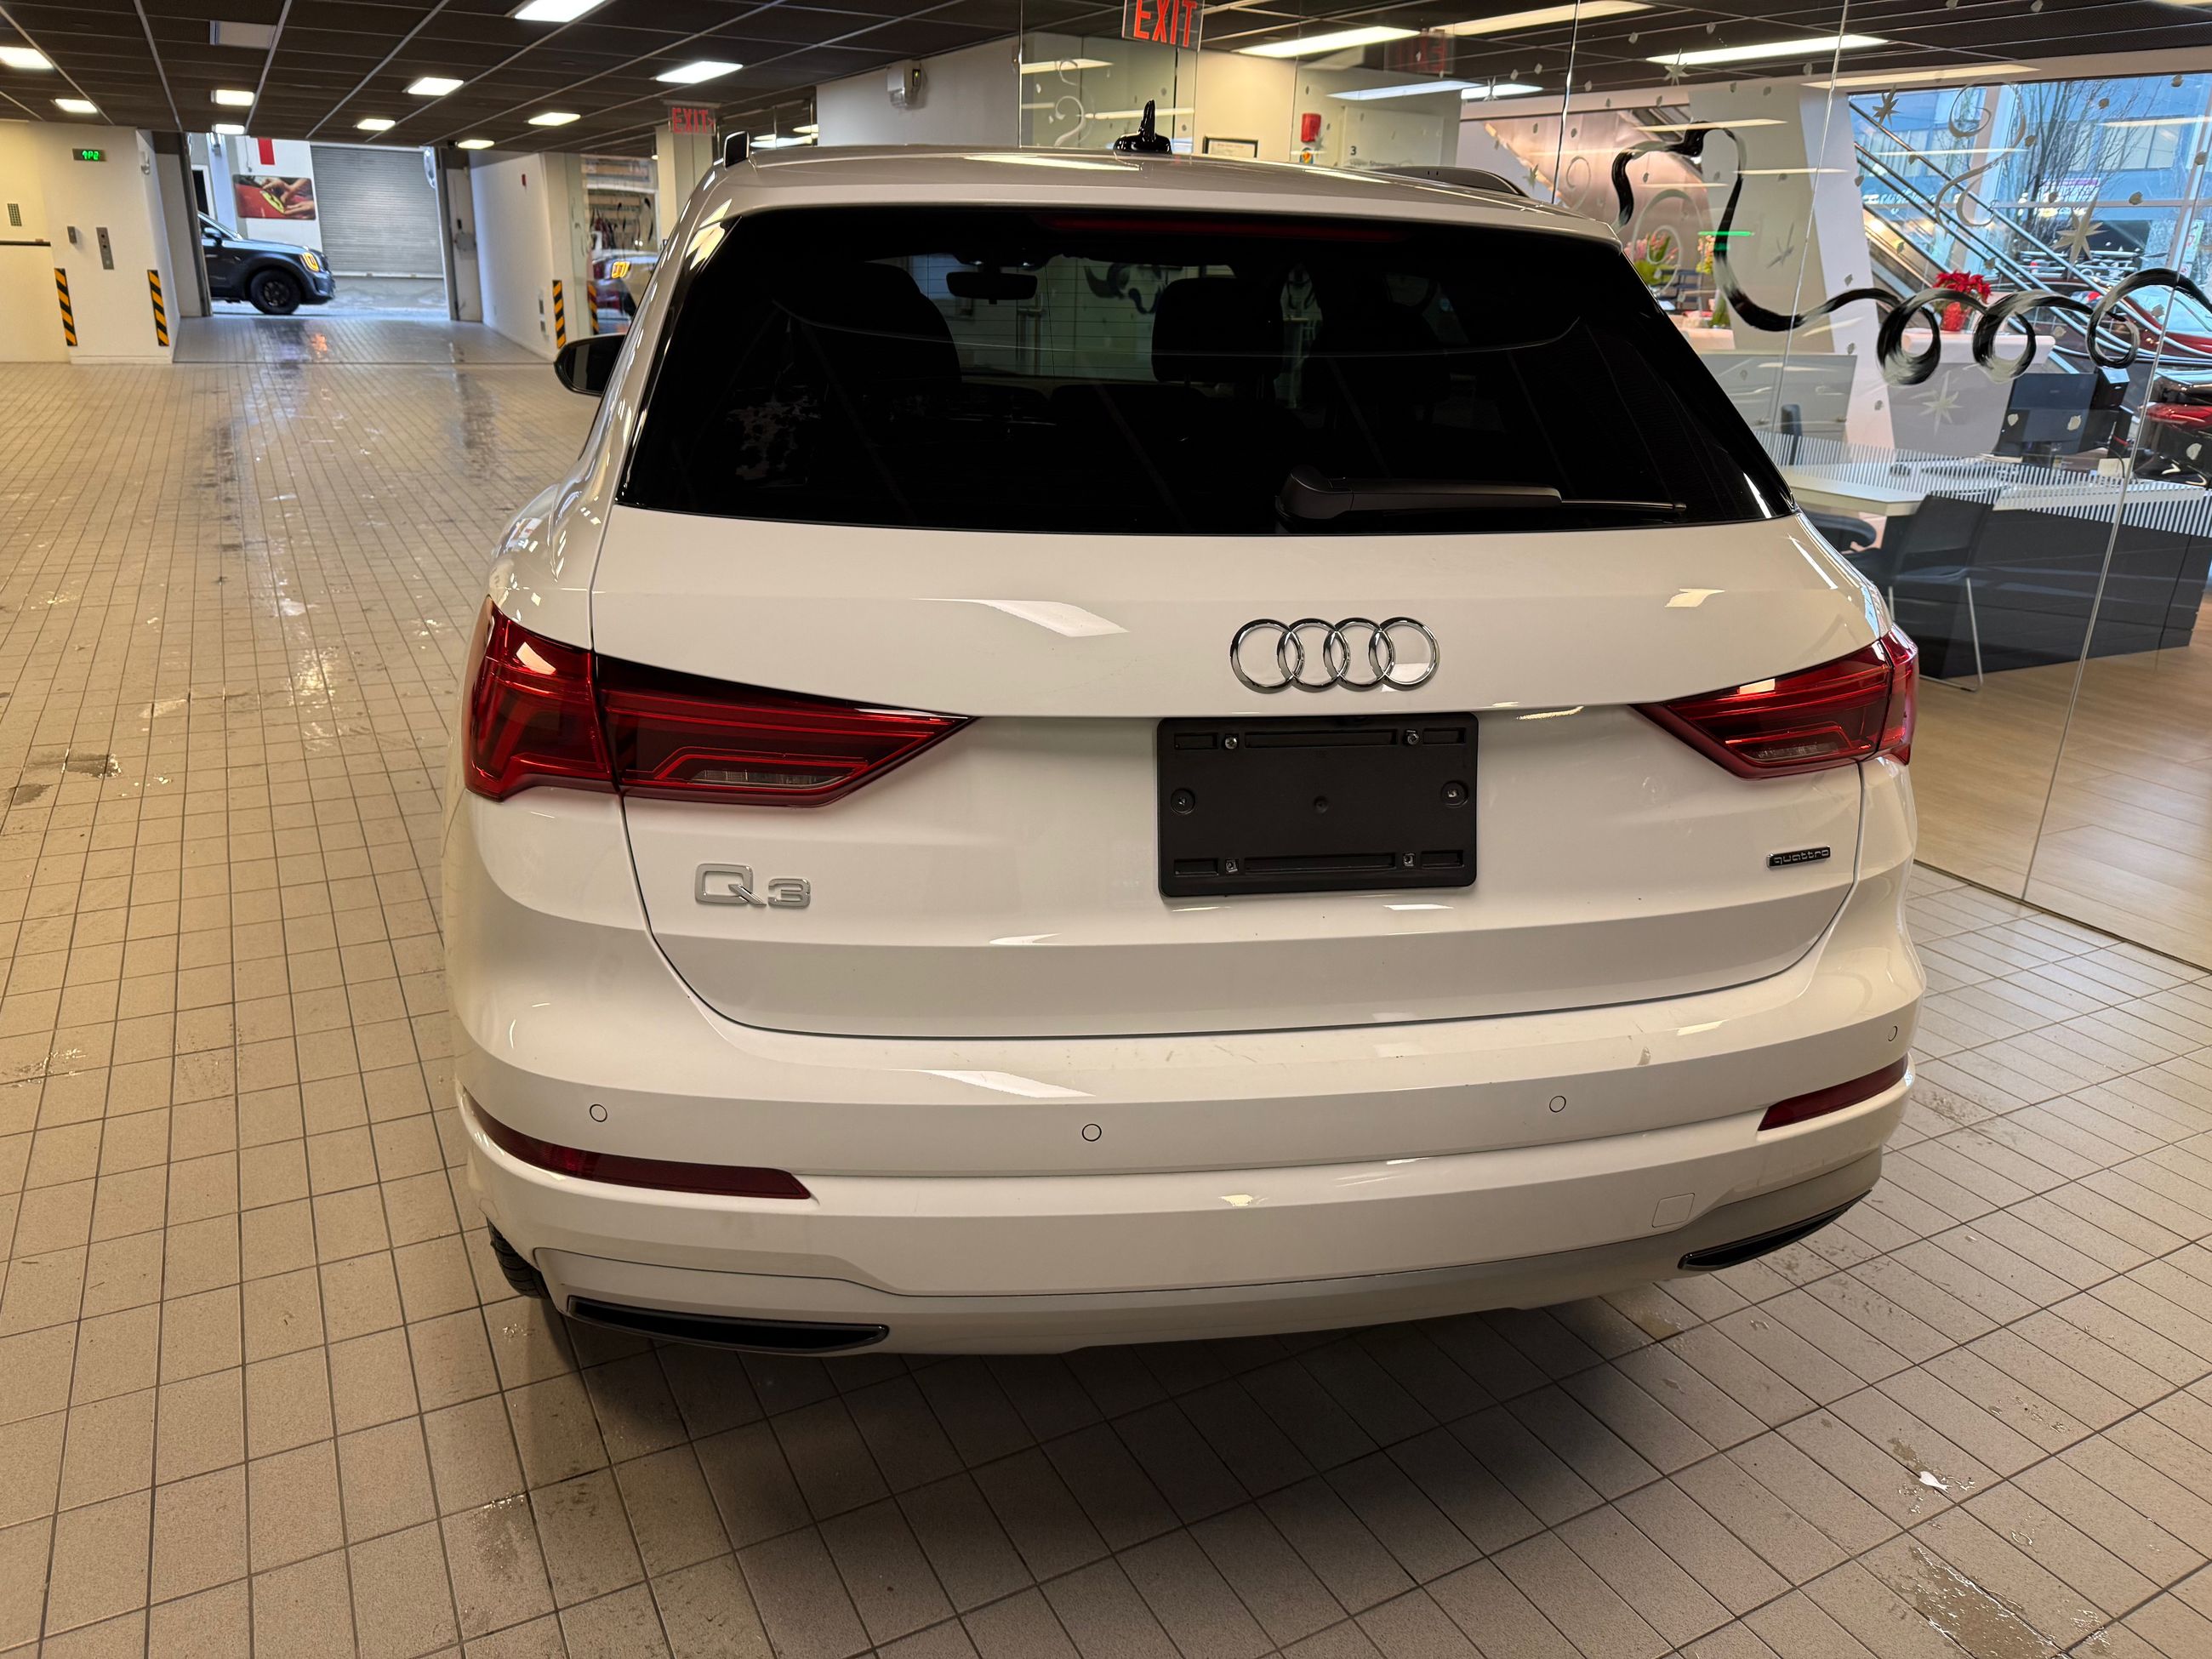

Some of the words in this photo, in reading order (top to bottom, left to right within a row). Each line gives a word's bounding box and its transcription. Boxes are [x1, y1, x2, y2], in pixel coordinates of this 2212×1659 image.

[1134, 0, 1198, 48] EXIT
[672, 107, 709, 134] EXIT
[1350, 145, 1357, 156] 3
[1774, 849, 1829, 865] quattro
[695, 863, 811, 909] Q3
